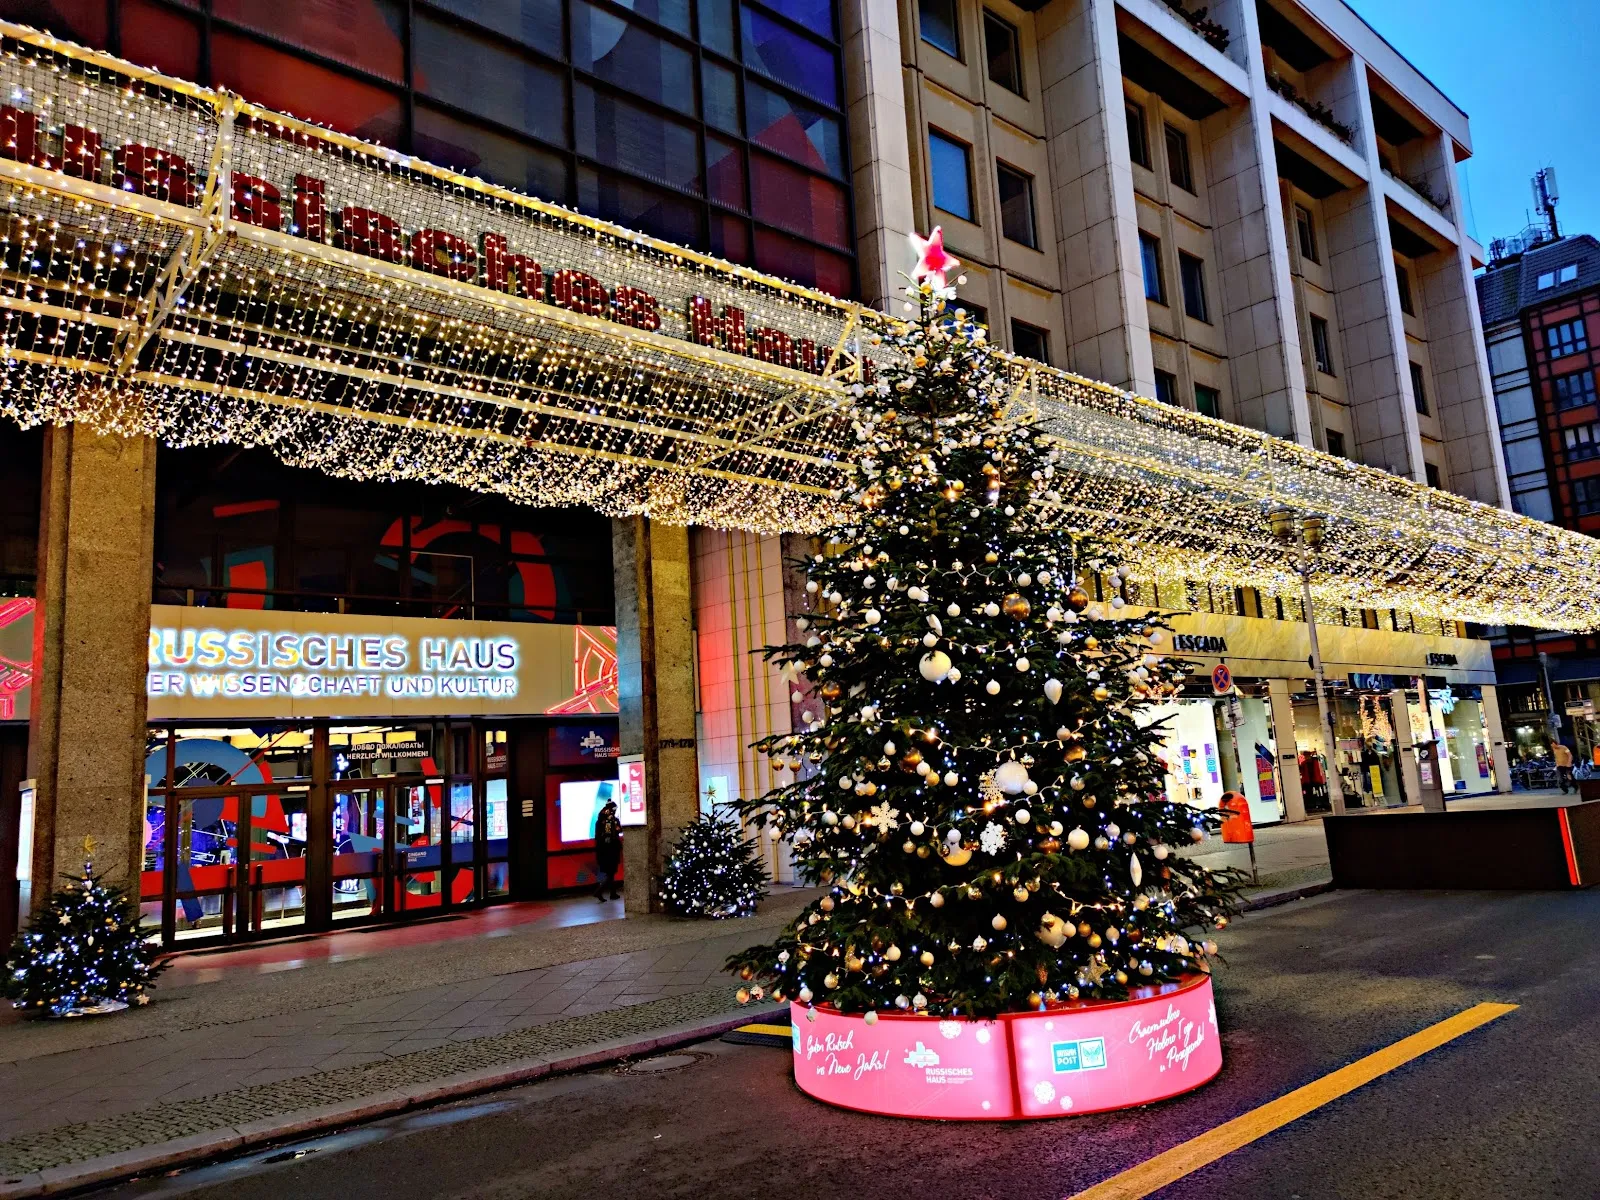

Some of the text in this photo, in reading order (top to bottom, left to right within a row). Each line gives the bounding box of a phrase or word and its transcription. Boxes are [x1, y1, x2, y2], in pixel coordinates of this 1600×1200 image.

[0, 104, 662, 331] ussisches
[148, 629, 516, 670] RUSSISCHES HAUS
[1172, 634, 1228, 653] ESCADA
[149, 673, 516, 695] ER WISSENSCHAFT UND KULTUR
[346, 750, 430, 760] HERZLICH WILLKOMMEN!
[351, 741, 425, 751] ДОБРО ПОЖАЛОВАТЬ!
[825, 1029, 854, 1052] Rutsch
[825, 1052, 852, 1076] Neue
[853, 1049, 890, 1081] Jahr!
[1056, 1055, 1078, 1066] POST
[925, 1067, 974, 1076] RUSSISCHES
[926, 1076, 947, 1084] HAUS
